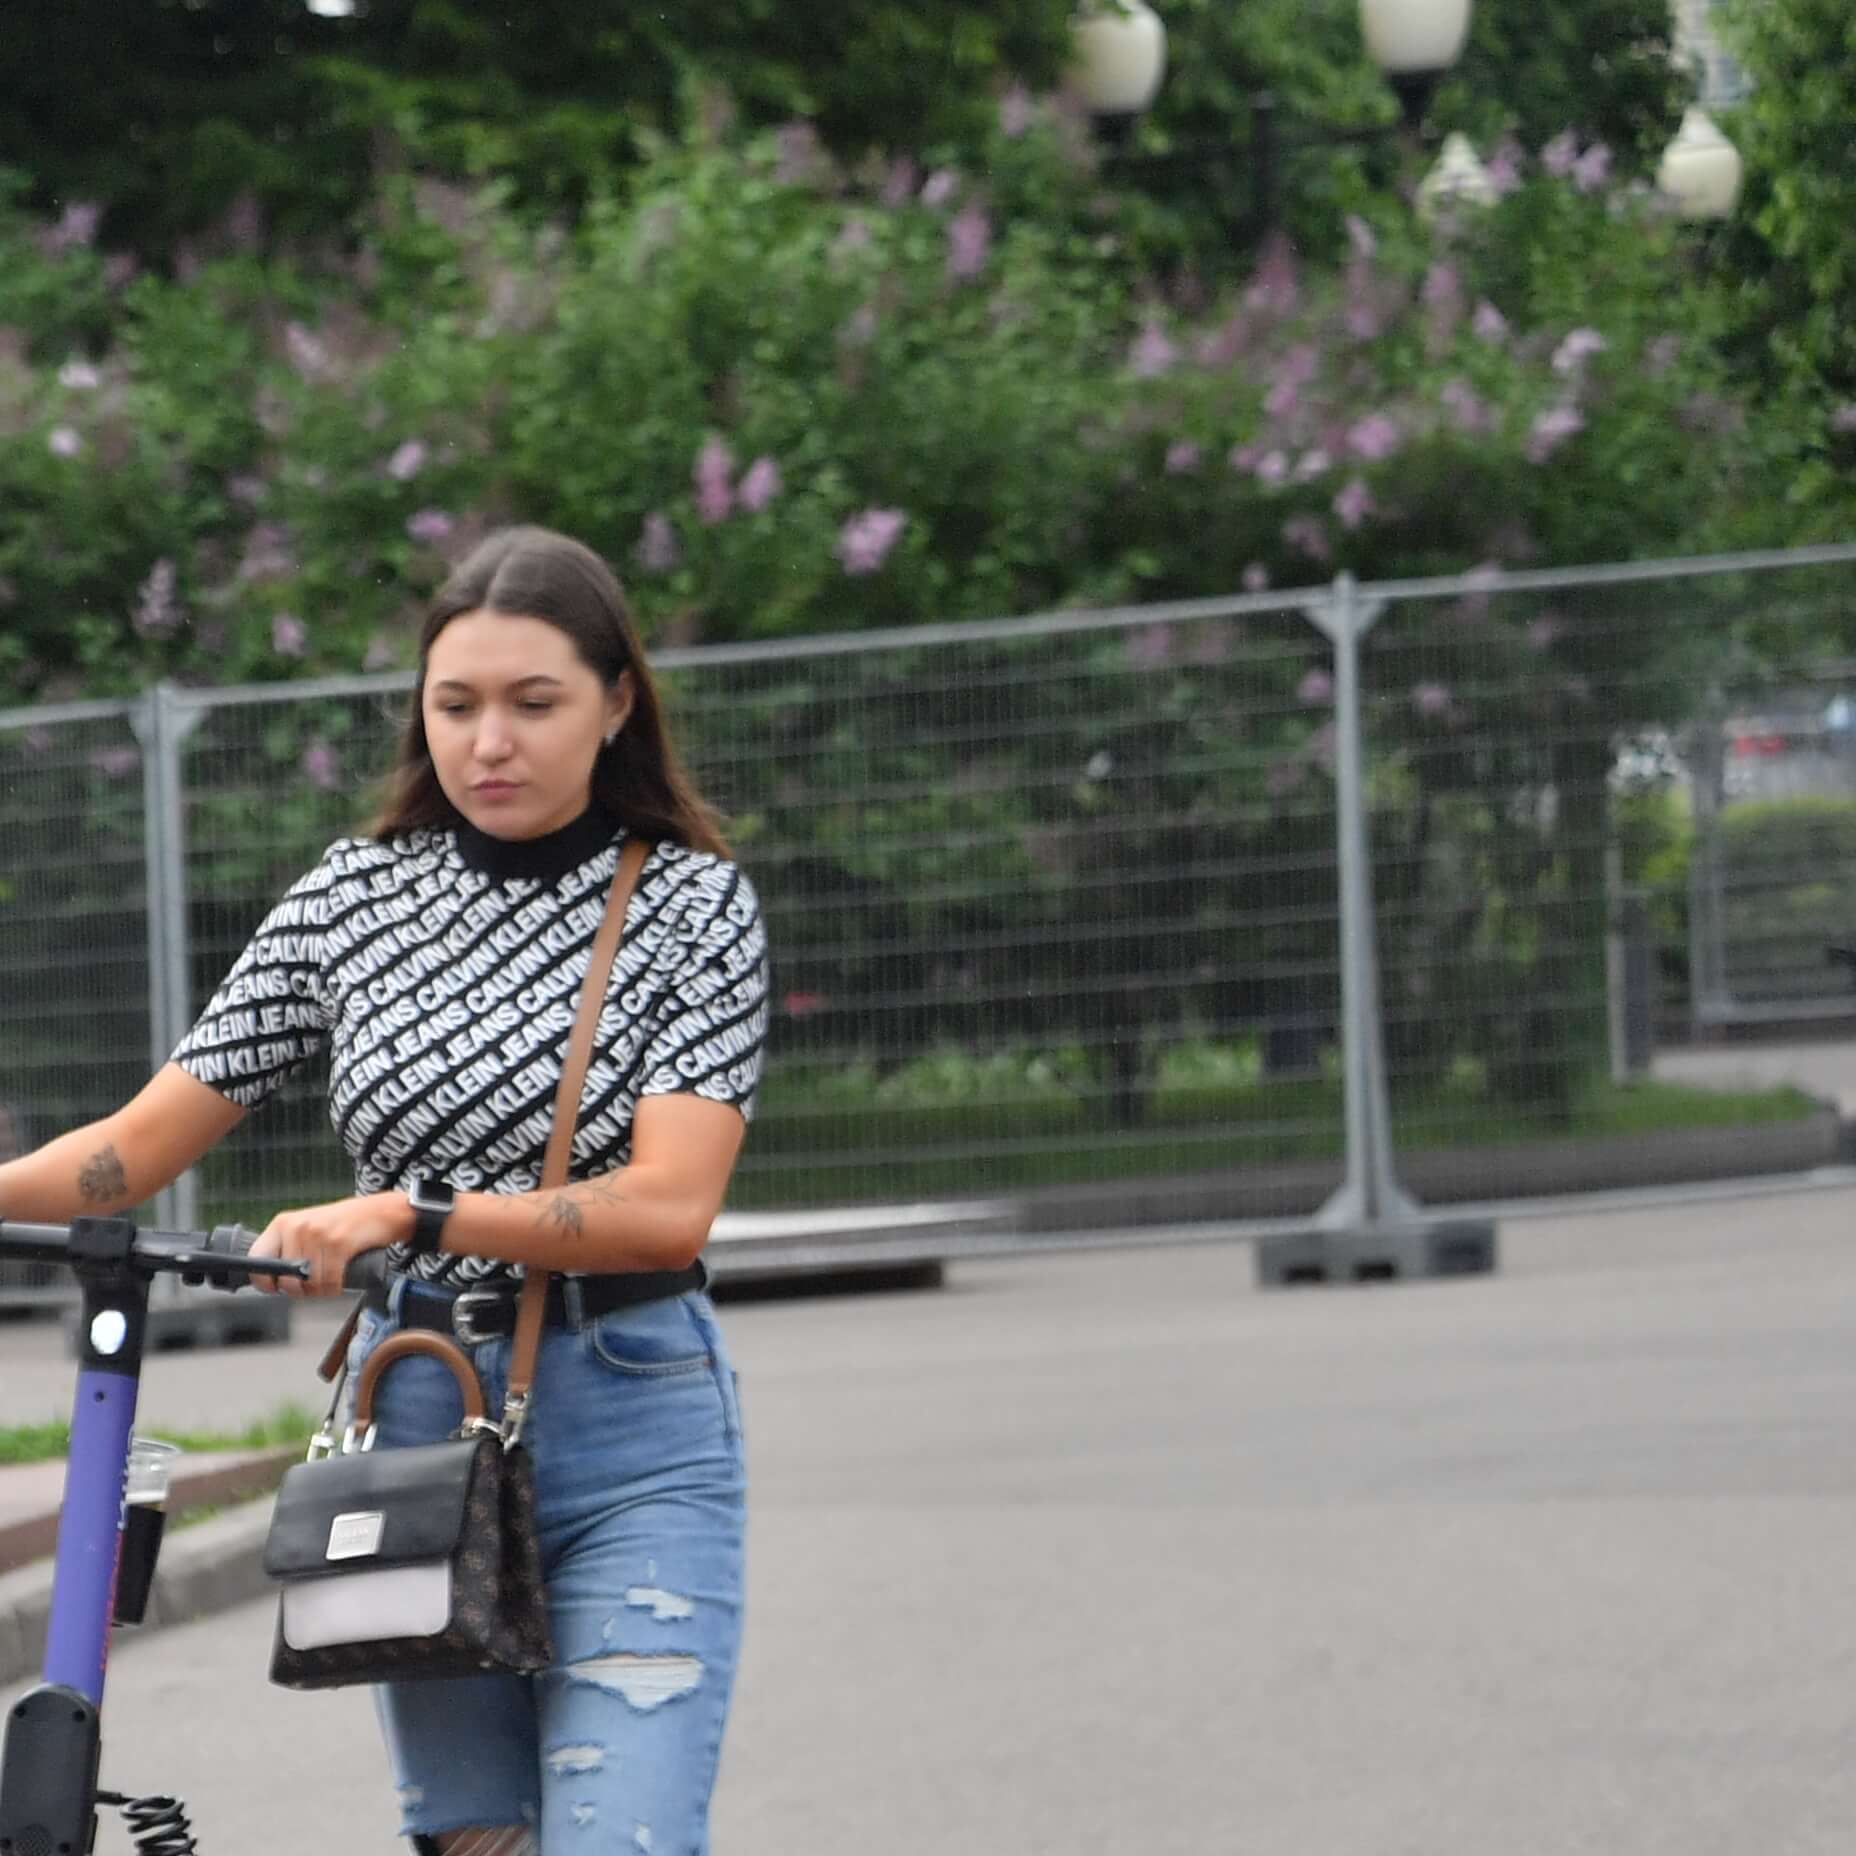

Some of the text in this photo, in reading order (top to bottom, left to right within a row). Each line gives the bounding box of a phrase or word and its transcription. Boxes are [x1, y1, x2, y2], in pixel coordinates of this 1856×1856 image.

[344, 891, 418, 942] KLEIN
[367, 851, 439, 899] JEANS
[222, 966, 290, 1007] JEANS
[326, 931, 402, 1000] CALVIN
[392, 892, 463, 949] KLEIN
[349, 995, 422, 1061] JEANS
[416, 940, 500, 1012] CALVIN
[487, 890, 562, 956] KLEIN
[555, 845, 620, 906] JEANS
[367, 941, 452, 1006] CALVIN
[441, 887, 511, 957] KLEIN
[393, 999, 471, 1063] JEANS
[465, 941, 551, 1014] CALVIN
[538, 894, 606, 957] KLEIN
[191, 1008, 257, 1050] KLEIN
[227, 1037, 298, 1077] KLEIN
[371, 1050, 450, 1115] KLEIN
[446, 1001, 524, 1067] JEANS
[371, 1099, 439, 1173] CALVIN
[426, 1052, 506, 1118] KLEIN
[500, 1001, 577, 1068] JEANS
[484, 1053, 562, 1121] KLEIN
